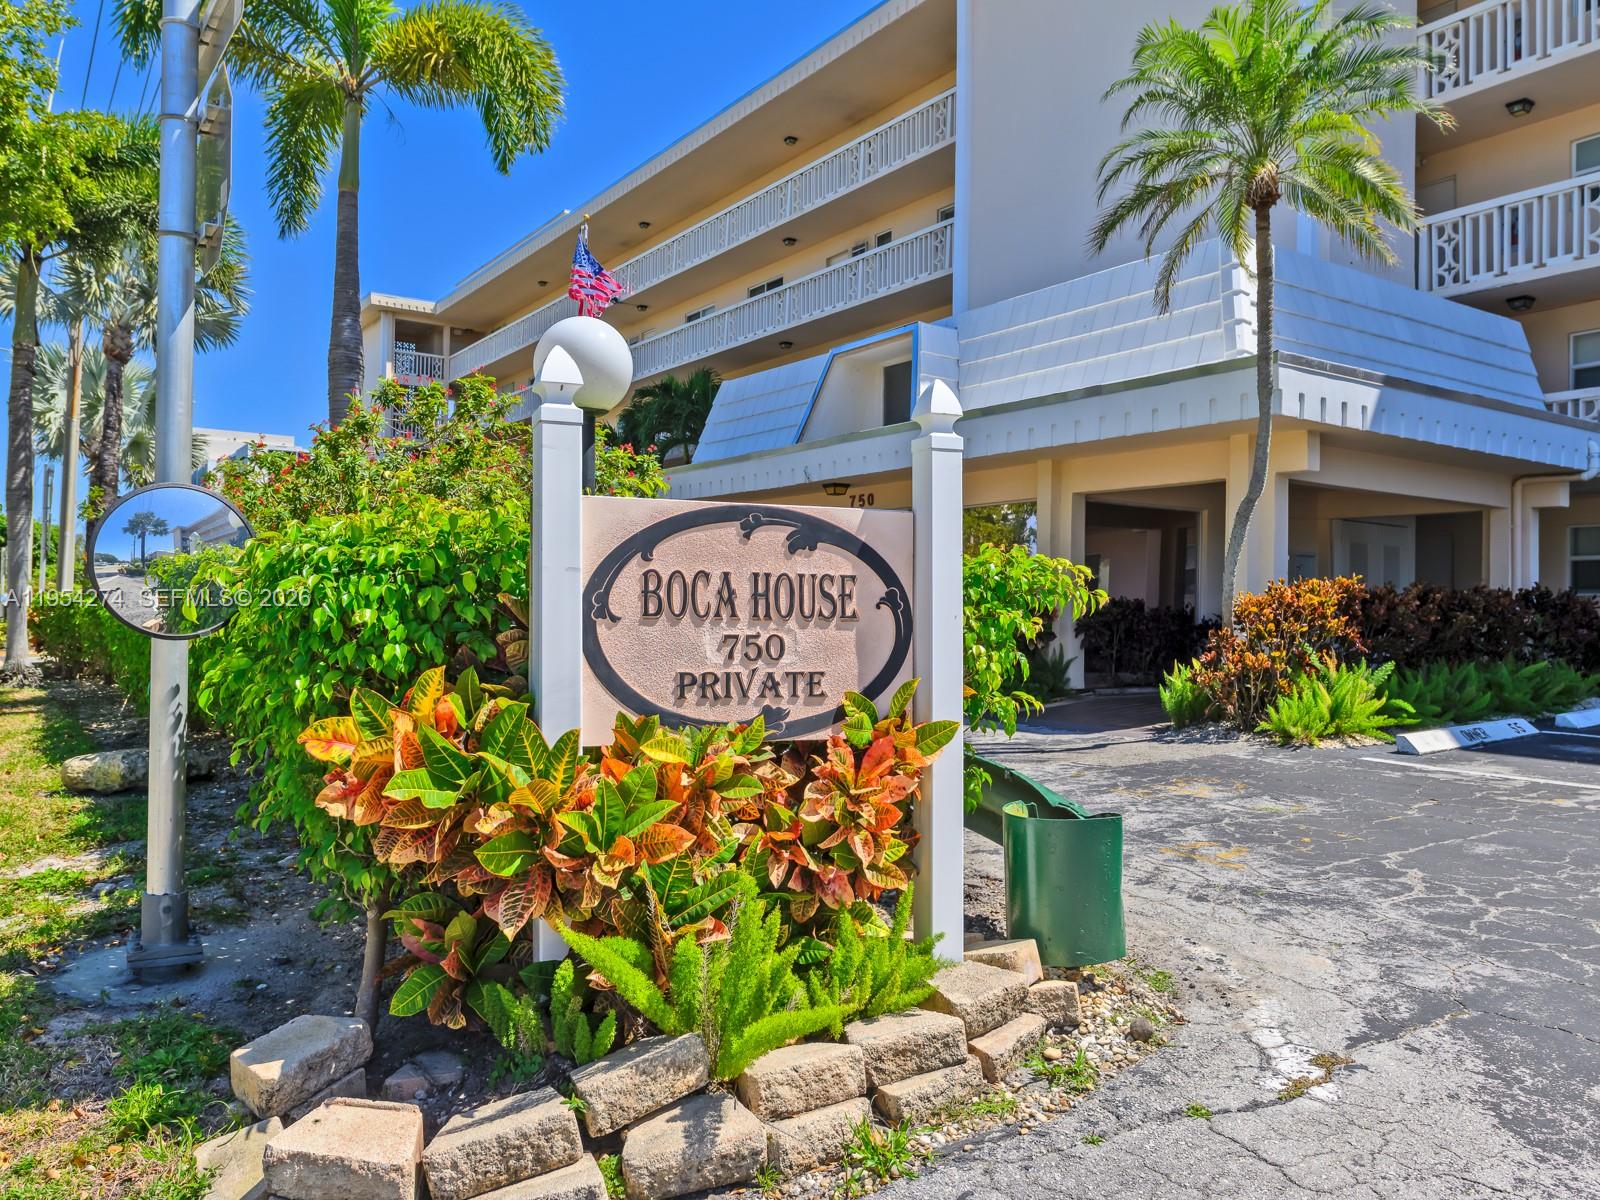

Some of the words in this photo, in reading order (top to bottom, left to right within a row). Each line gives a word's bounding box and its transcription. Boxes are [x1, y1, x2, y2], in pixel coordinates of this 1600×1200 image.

[849, 493, 875, 508] 750
[641, 569, 738, 620] BOCA
[750, 571, 858, 622] HOUSE
[721, 633, 786, 662] 750
[676, 666, 827, 700] PRIVATE
